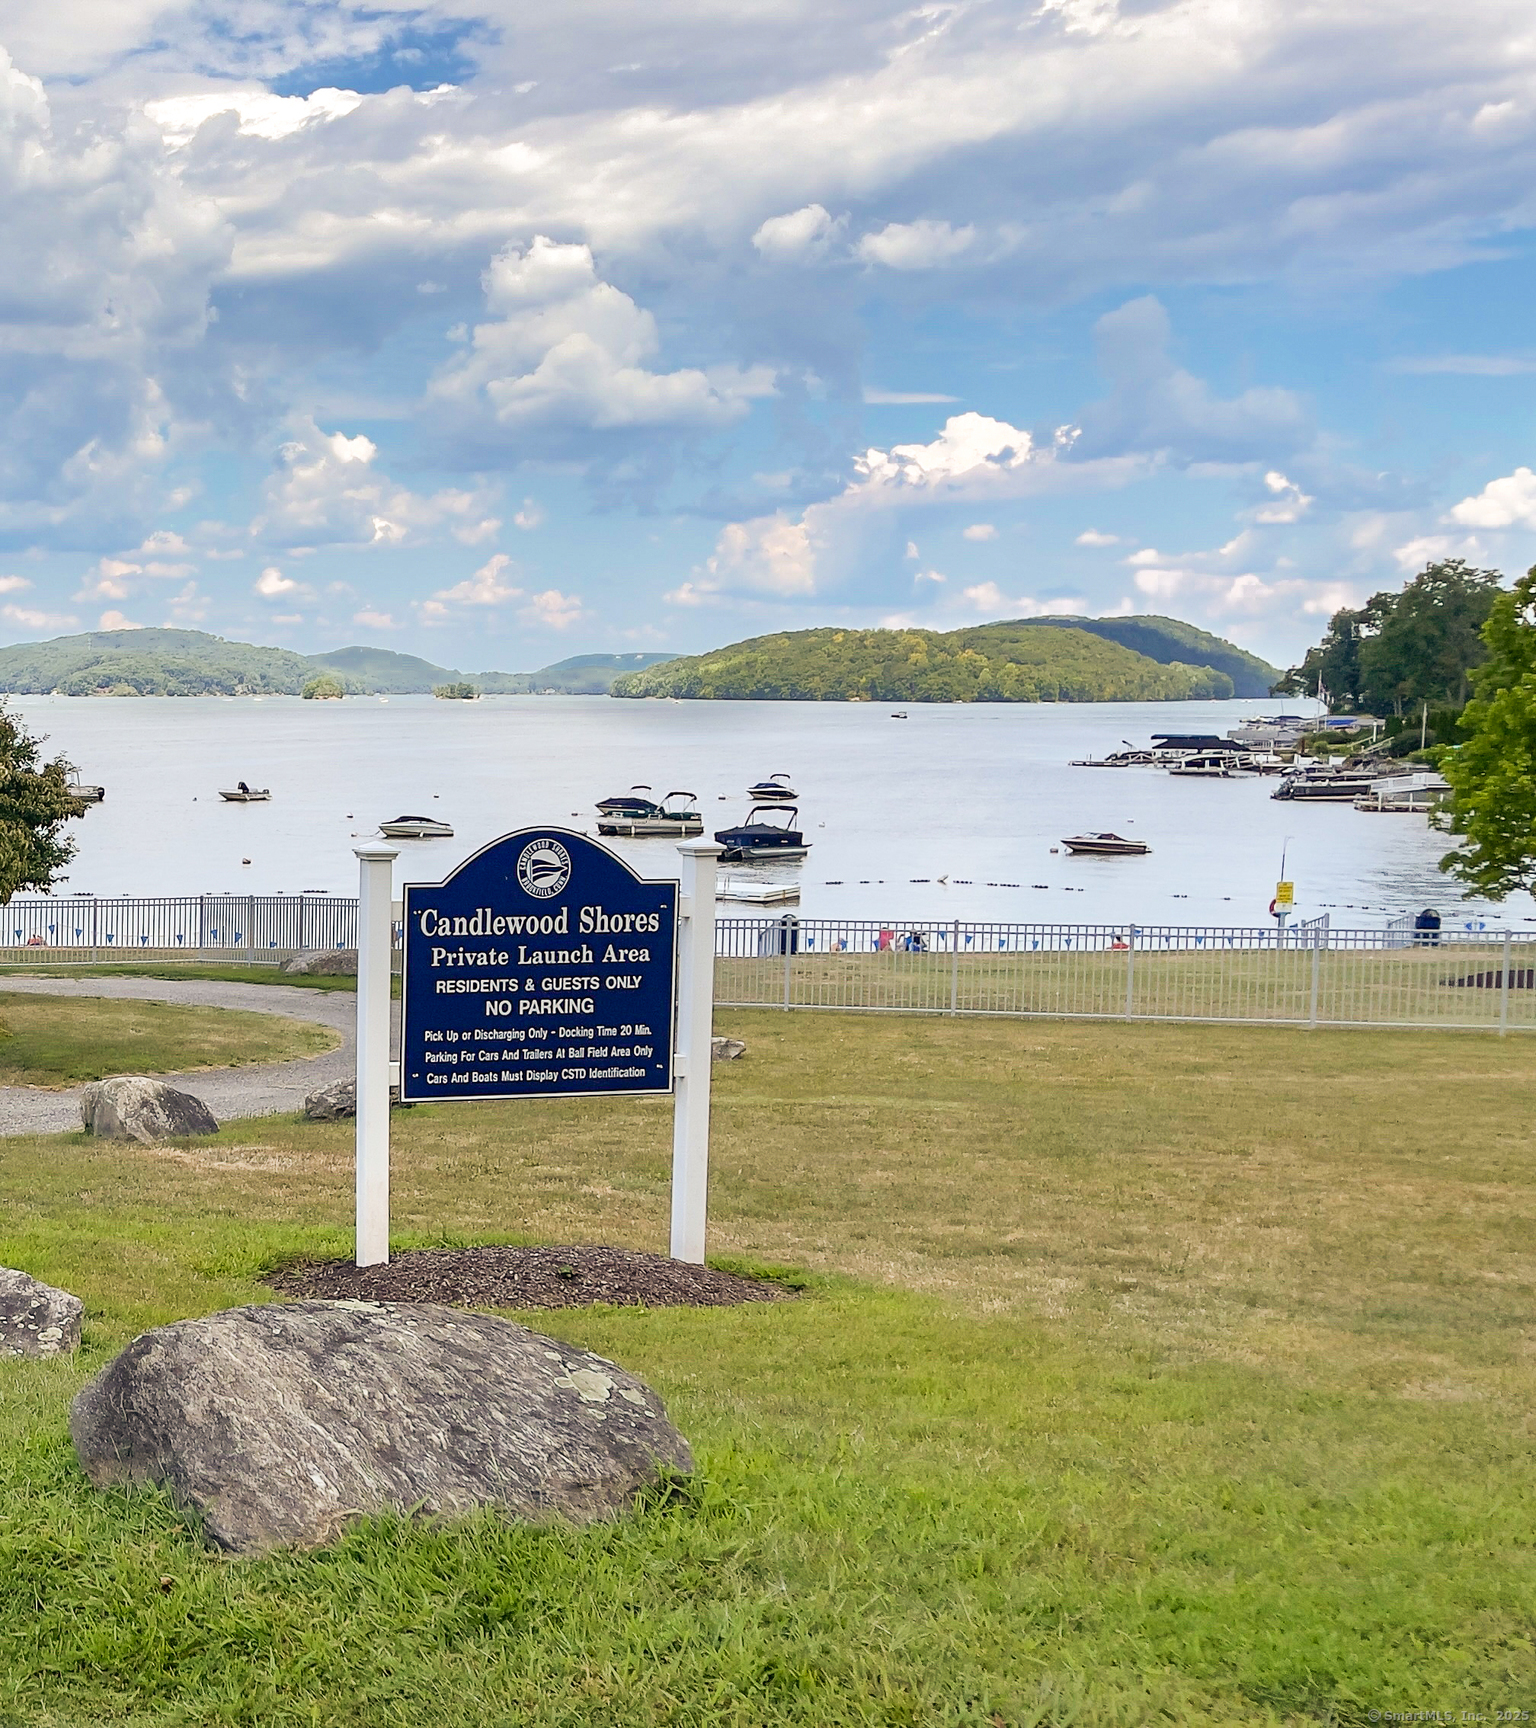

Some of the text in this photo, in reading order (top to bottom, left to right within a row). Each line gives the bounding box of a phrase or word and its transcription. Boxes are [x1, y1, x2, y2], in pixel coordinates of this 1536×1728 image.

[420, 905, 659, 937] Candlewood Shores
[430, 943, 651, 967] Private Launch Area
[436, 975, 642, 994] RESIDENTS & GUESTS ONLY
[485, 997, 594, 1016] NO PARKING
[424, 1030, 443, 1042] Pick
[446, 1030, 459, 1043] Up
[461, 1031, 472, 1041] or
[474, 1028, 526, 1042] Discharging
[528, 1027, 548, 1040] Only
[558, 1026, 594, 1039] Docking
[596, 1025, 617, 1037] Time
[620, 1024, 632, 1036] 20
[634, 1024, 652, 1036] Min.
[425, 1044, 654, 1065] Parking For Cars And Trailers At Ball Field Area Only
[426, 1066, 646, 1085] Cars And Boats Must Display CSTD Identification
